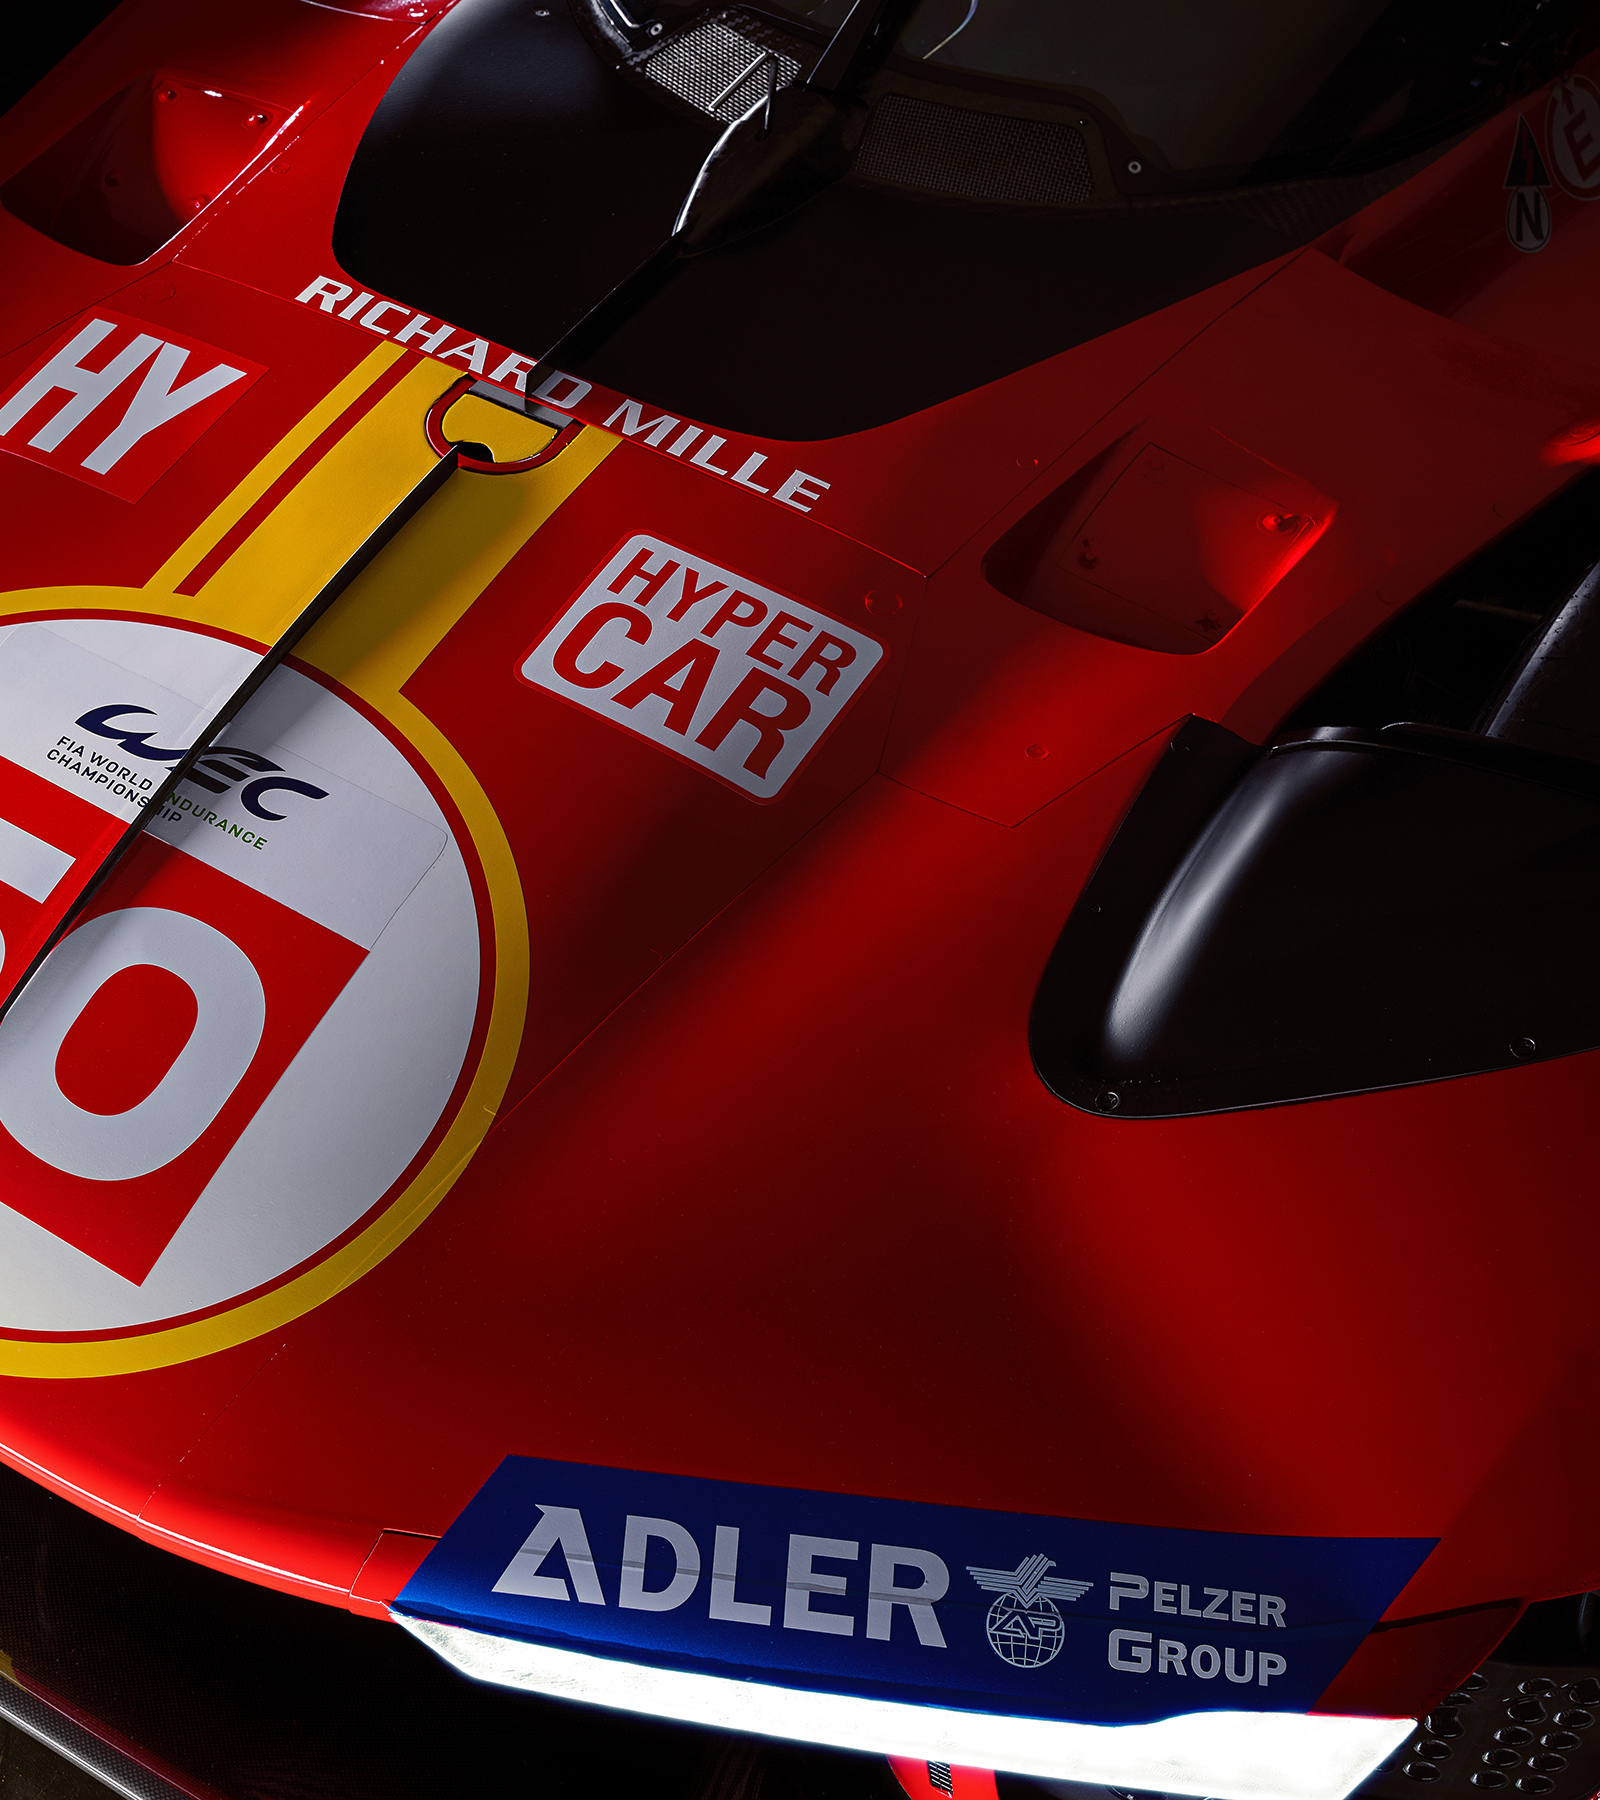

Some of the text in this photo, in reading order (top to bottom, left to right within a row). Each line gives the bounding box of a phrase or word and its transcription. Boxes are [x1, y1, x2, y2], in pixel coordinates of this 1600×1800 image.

[1516, 191, 1544, 242] N
[295, 275, 831, 513] RICHARD MILLE
[606, 547, 857, 697] HYPER
[552, 602, 813, 779] CAR
[46, 748, 183, 824] CHAMPIONSIP
[56, 735, 267, 850] FIA WORLD NDURANCE
[492, 1504, 949, 1648] ADLER
[1109, 1571, 1288, 1629] PELZER
[1108, 1629, 1288, 1687] GROUP
